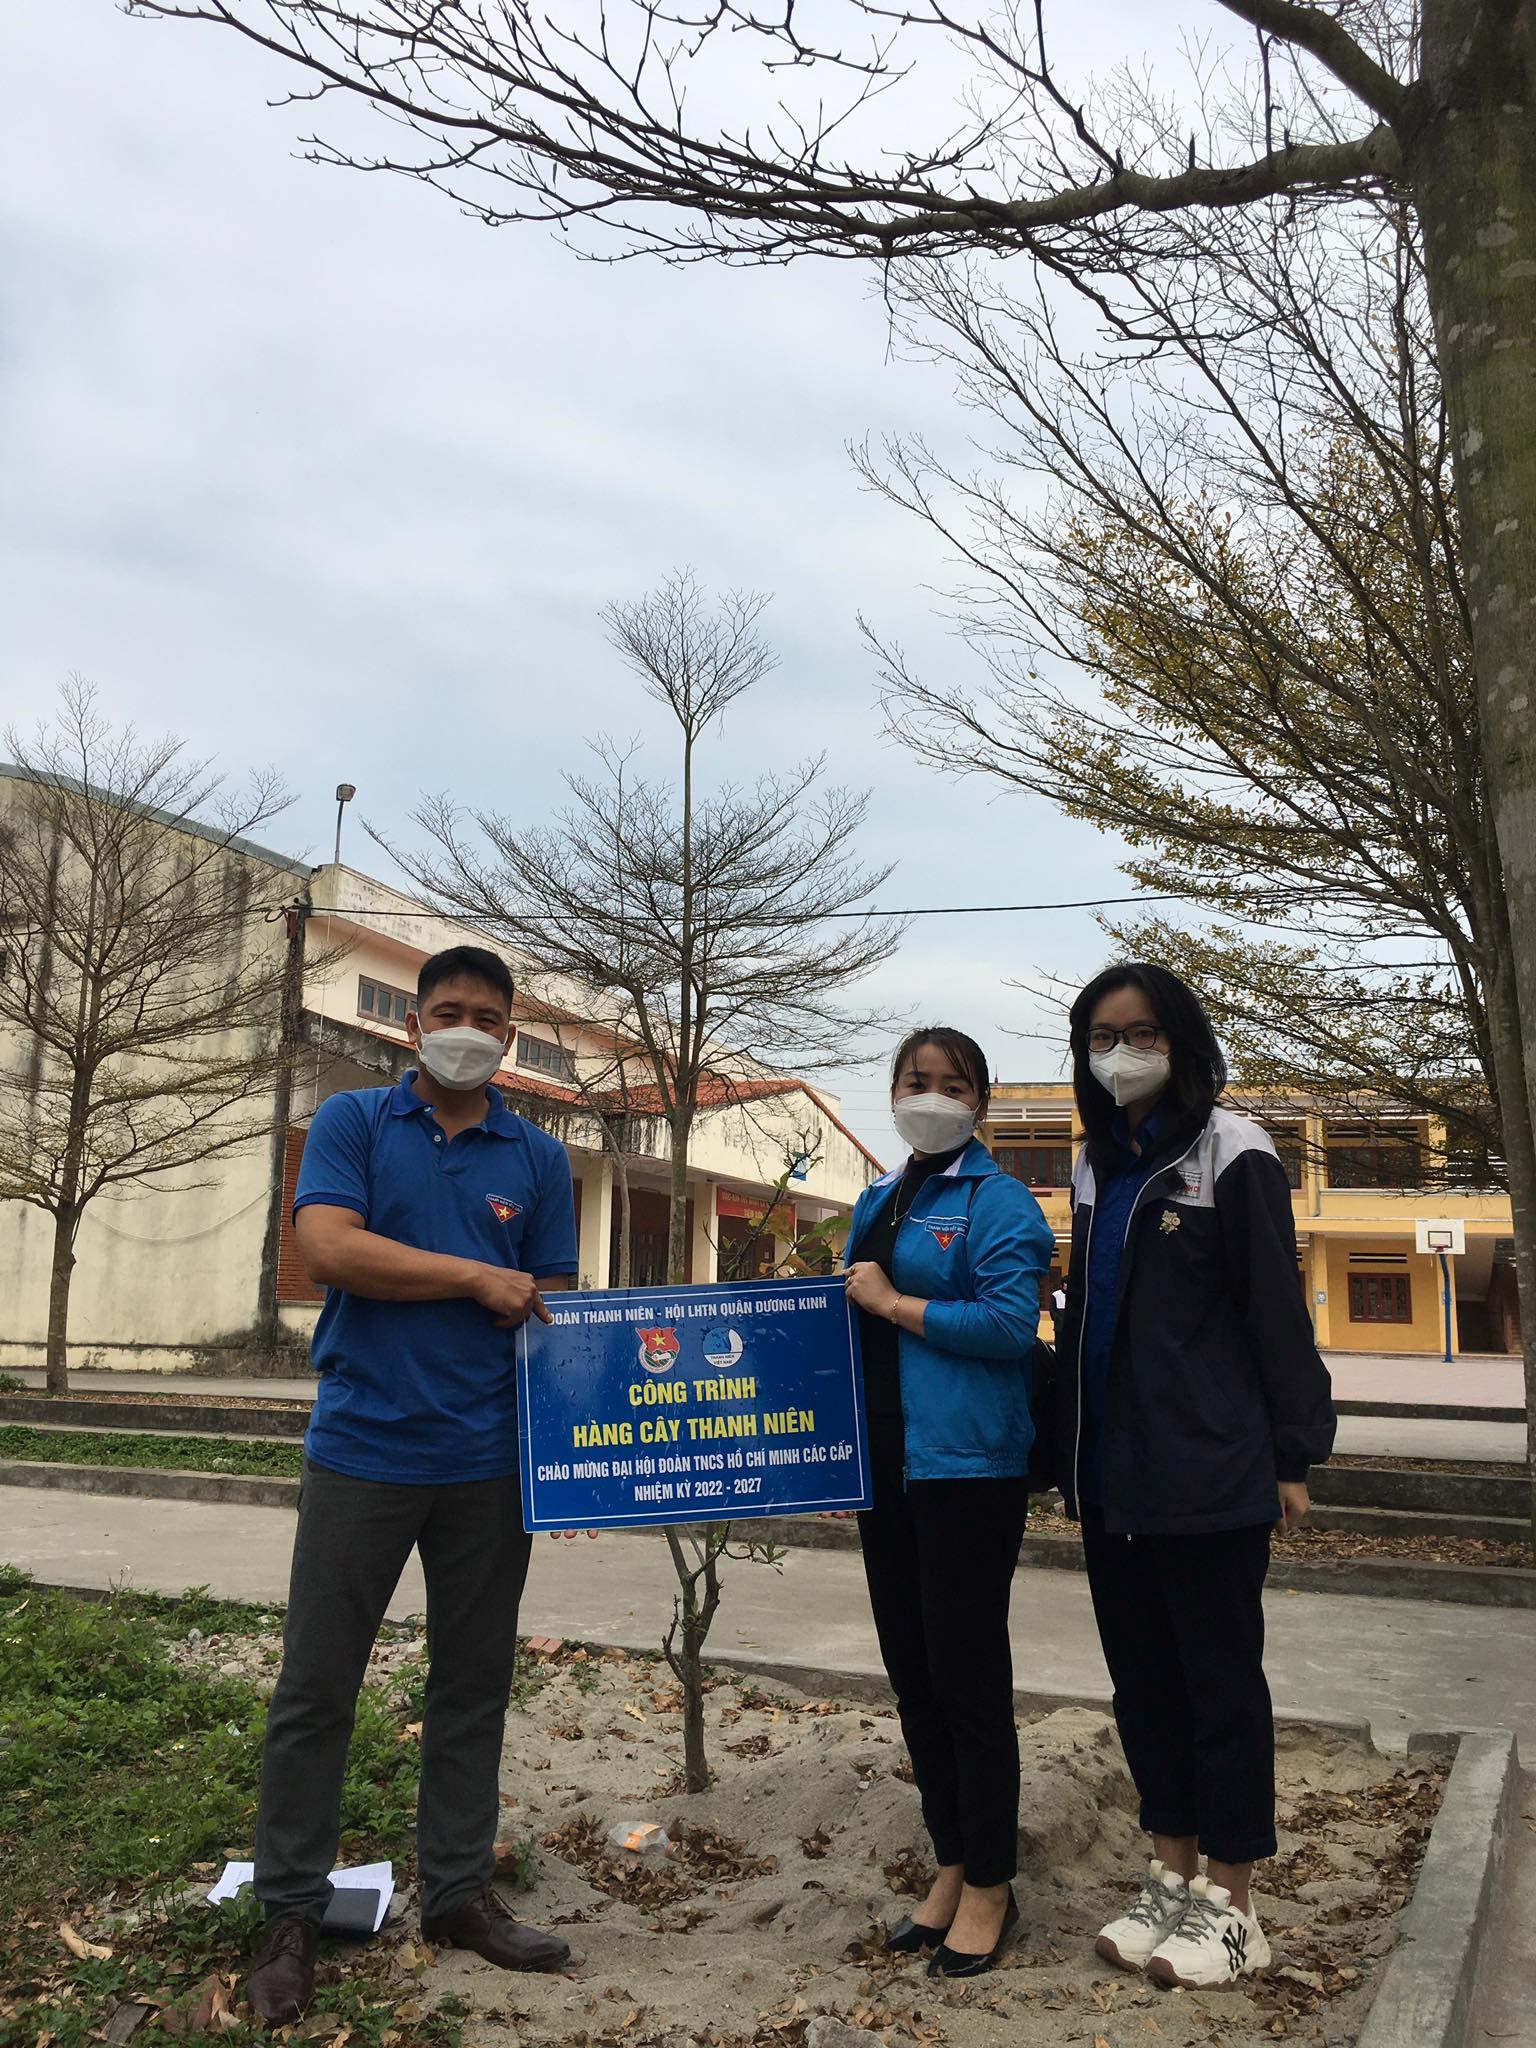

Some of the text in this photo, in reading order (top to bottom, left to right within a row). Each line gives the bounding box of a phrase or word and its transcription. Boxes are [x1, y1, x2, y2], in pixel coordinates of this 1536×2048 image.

[583, 1308, 622, 1324] THANH
[625, 1305, 654, 1321] NIÊN
[665, 1303, 685, 1321] HỘI
[688, 1303, 717, 1318] LHTN
[720, 1300, 752, 1317] QUẬN
[799, 1296, 827, 1310] KINH
[628, 1374, 757, 1407] CÔNG TRÌNH
[572, 1407, 816, 1448] HÀNG CÂY THANH NIÊN
[537, 1439, 853, 1481] CHÀO MỪNG ĐẠI HỘI ĐOÀN TNCS HỒ CHÍ MINH CÁC CẤP
[634, 1481, 674, 1503] NHIỆM
[676, 1479, 692, 1499] KỲ
[694, 1480, 723, 1497] 2022
[733, 1477, 762, 1494] 2027
